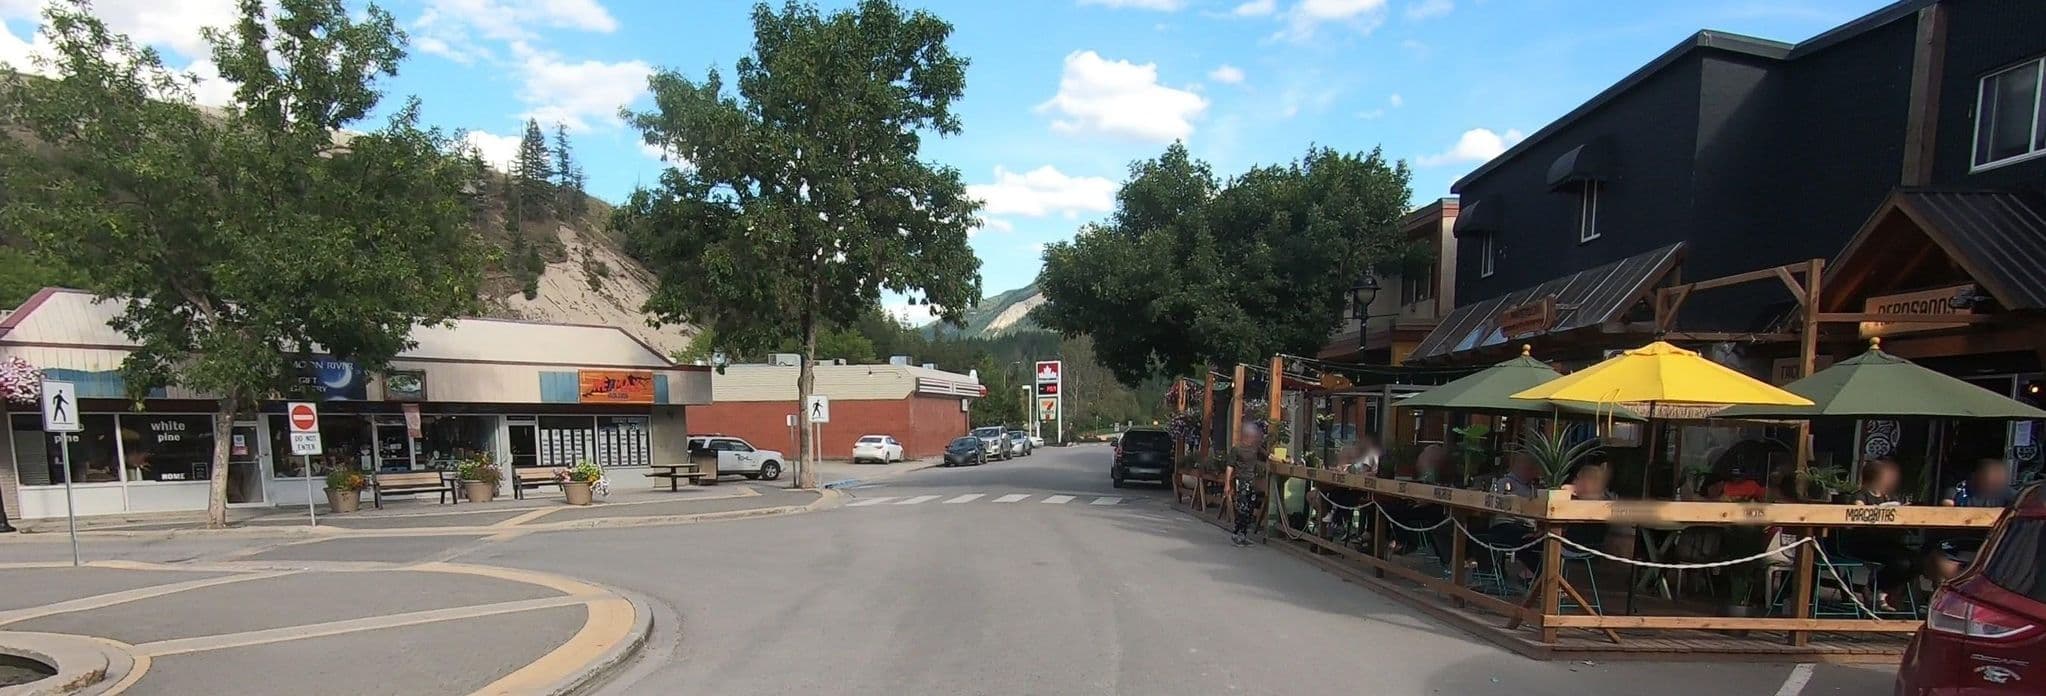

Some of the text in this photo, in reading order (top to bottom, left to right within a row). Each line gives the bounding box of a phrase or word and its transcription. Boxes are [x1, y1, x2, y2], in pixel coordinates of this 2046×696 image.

[151, 420, 186, 431] white
[54, 434, 80, 444] pne
[157, 433, 181, 443] pine
[161, 473, 186, 481] HOME
[1846, 508, 1896, 523] MARGARITAS
